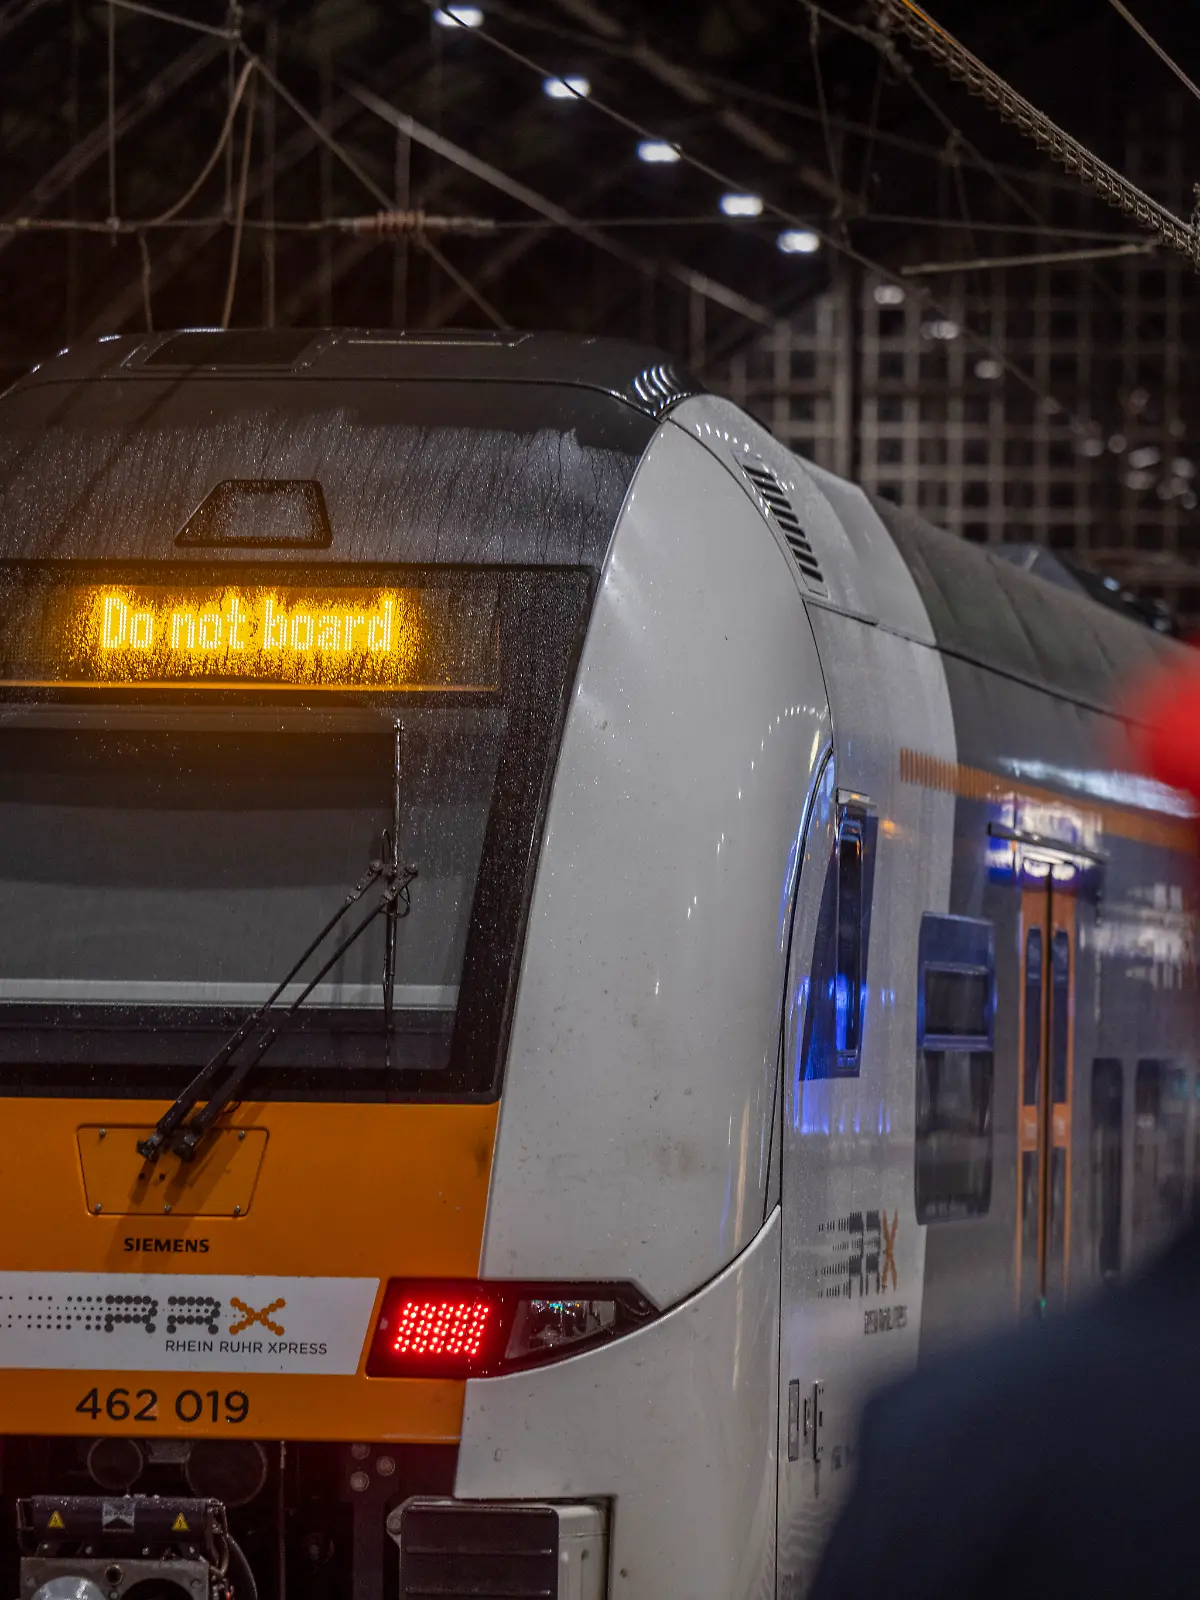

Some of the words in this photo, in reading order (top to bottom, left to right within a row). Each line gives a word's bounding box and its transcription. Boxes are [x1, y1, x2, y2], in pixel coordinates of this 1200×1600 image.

[102, 597, 153, 649] Do
[171, 598, 246, 650] not
[263, 599, 393, 652] board
[124, 1237, 210, 1253] SIEMENS
[165, 1340, 213, 1353] RHEIN
[219, 1341, 263, 1354] RUHR
[268, 1342, 328, 1356] XPRESS
[75, 1388, 158, 1422] 462
[175, 1389, 250, 1424] 019
